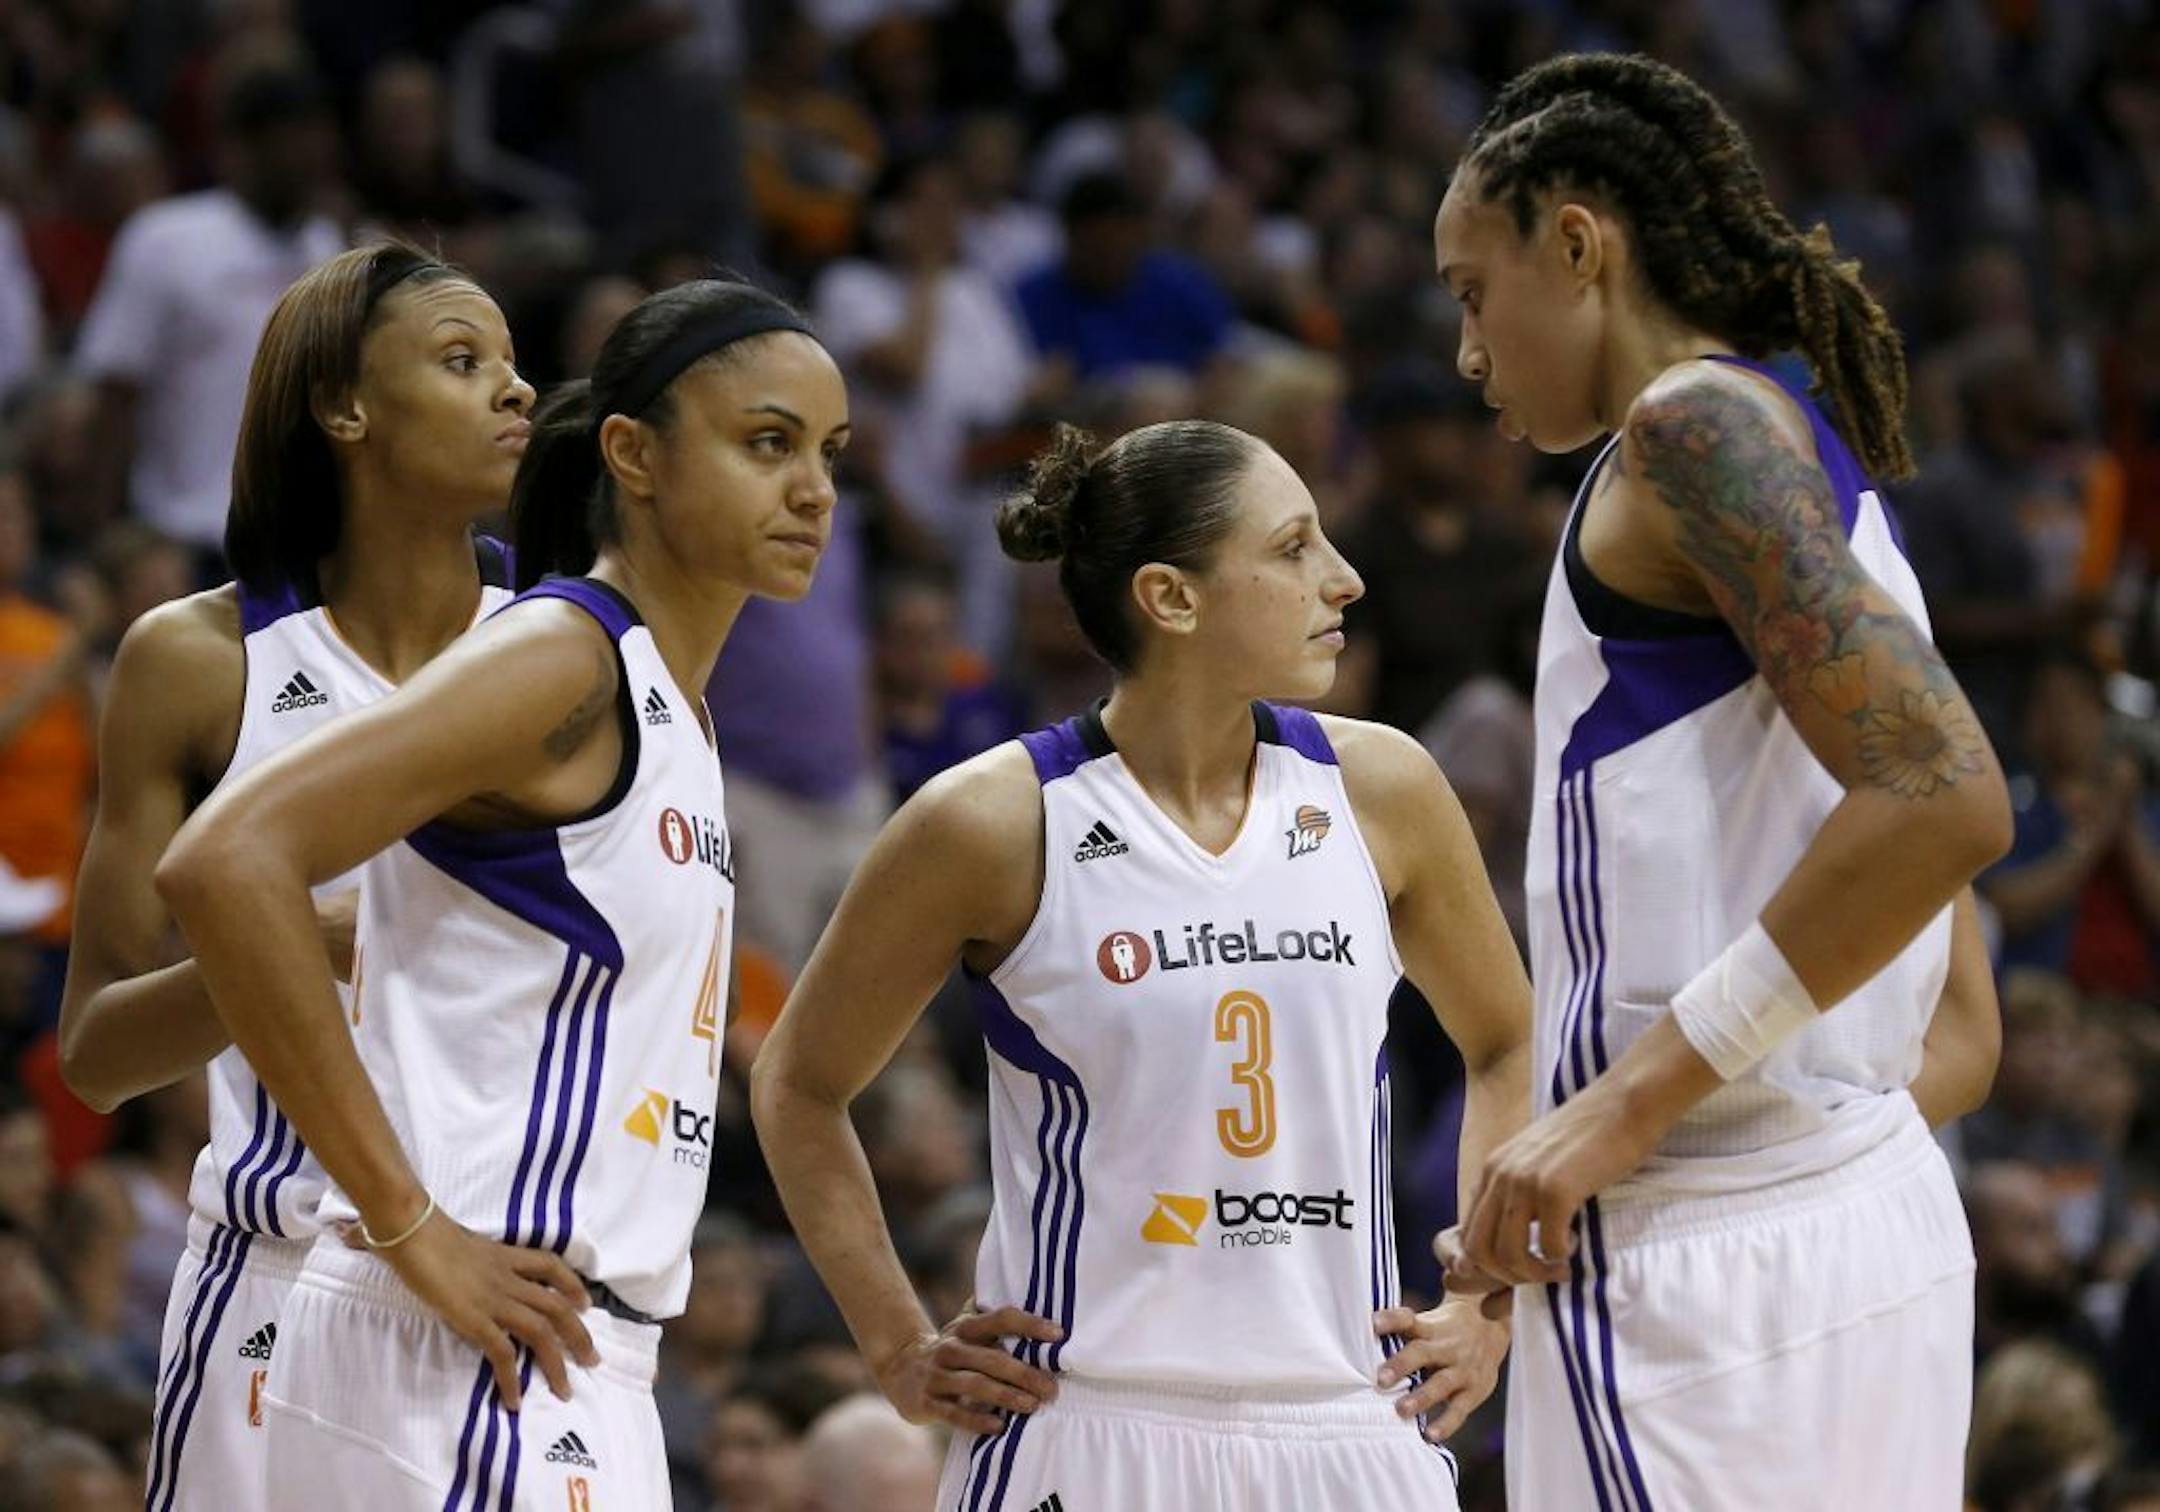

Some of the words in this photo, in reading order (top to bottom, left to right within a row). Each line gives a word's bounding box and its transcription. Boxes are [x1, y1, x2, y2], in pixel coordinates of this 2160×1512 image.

[271, 692, 328, 713] adidas
[1074, 842, 1129, 862] adidas
[1153, 919, 1356, 970] LifeLock
[1214, 990, 1277, 1158] 3
[1215, 1189, 1354, 1230] boost
[1220, 1226, 1292, 1249] mobile
[545, 1449, 597, 1470] adidas
